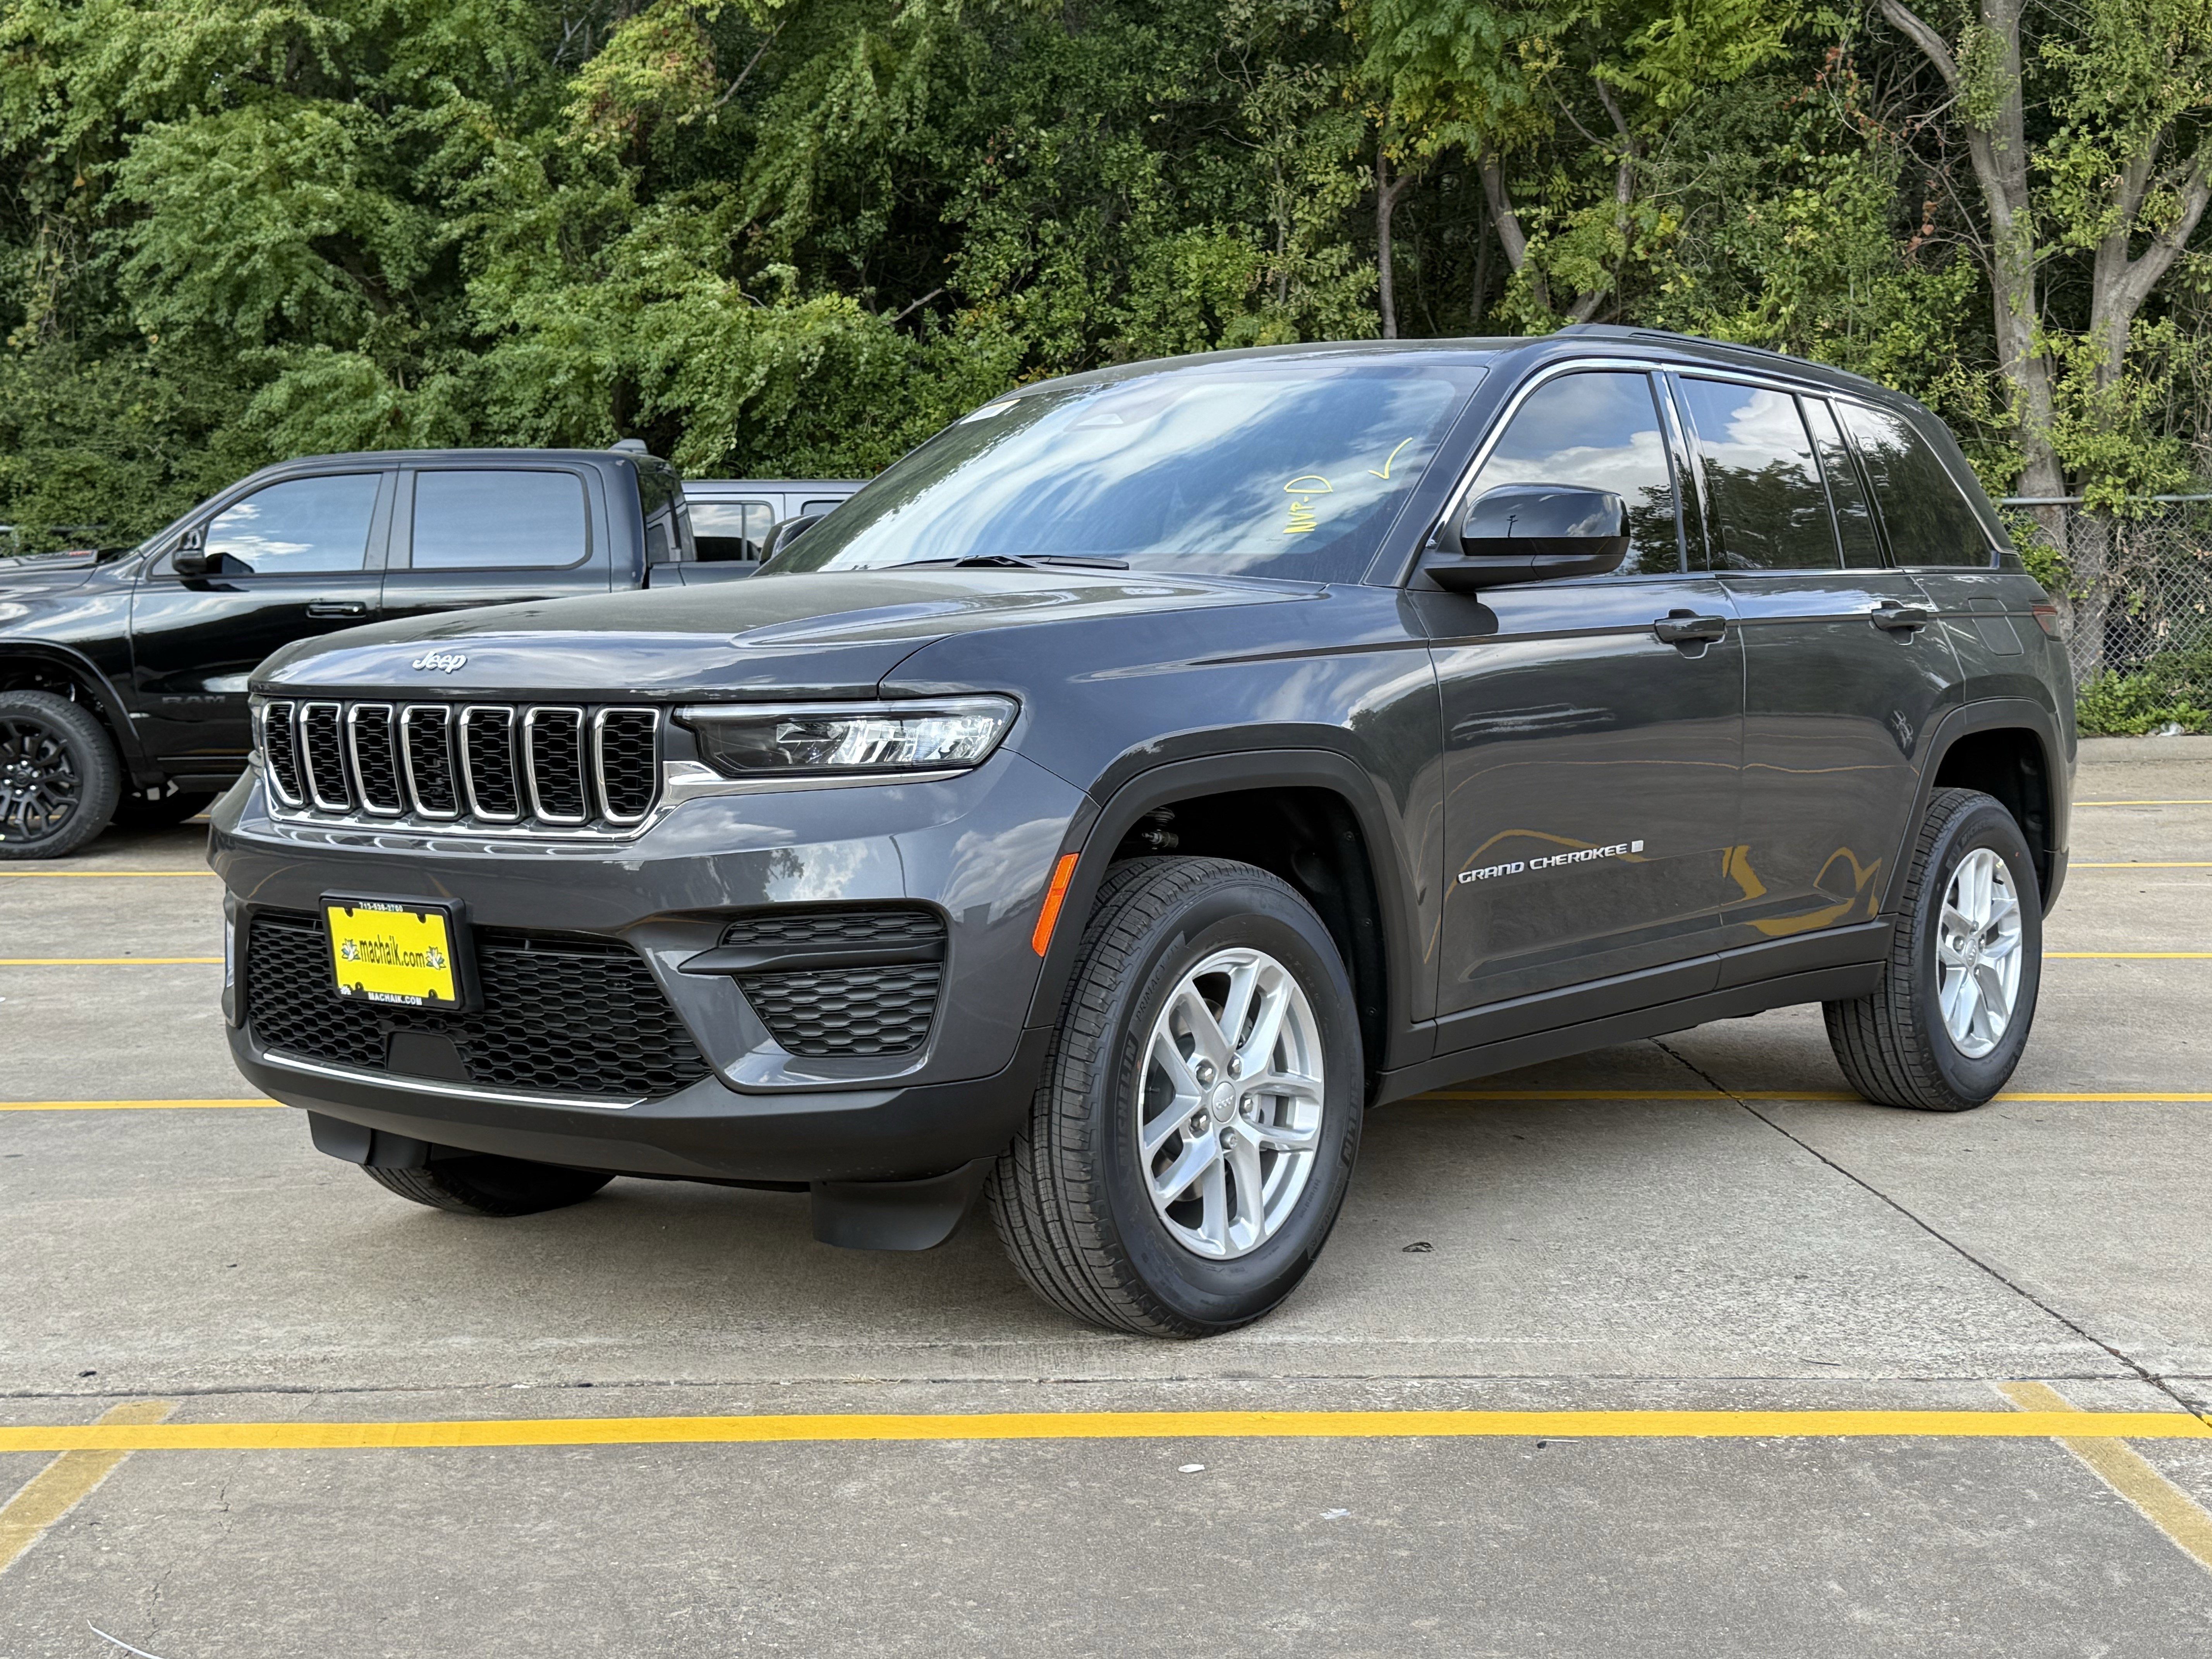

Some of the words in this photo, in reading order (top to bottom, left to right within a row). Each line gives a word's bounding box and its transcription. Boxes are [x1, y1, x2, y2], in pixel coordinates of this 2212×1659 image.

[412, 651, 467, 673] Jeep
[1458, 862, 1524, 884] GRAND
[1530, 843, 1628, 870] CHEROKEE
[359, 934, 426, 968] machaik.com
[368, 992, 422, 1006] MACHAIK.COM
